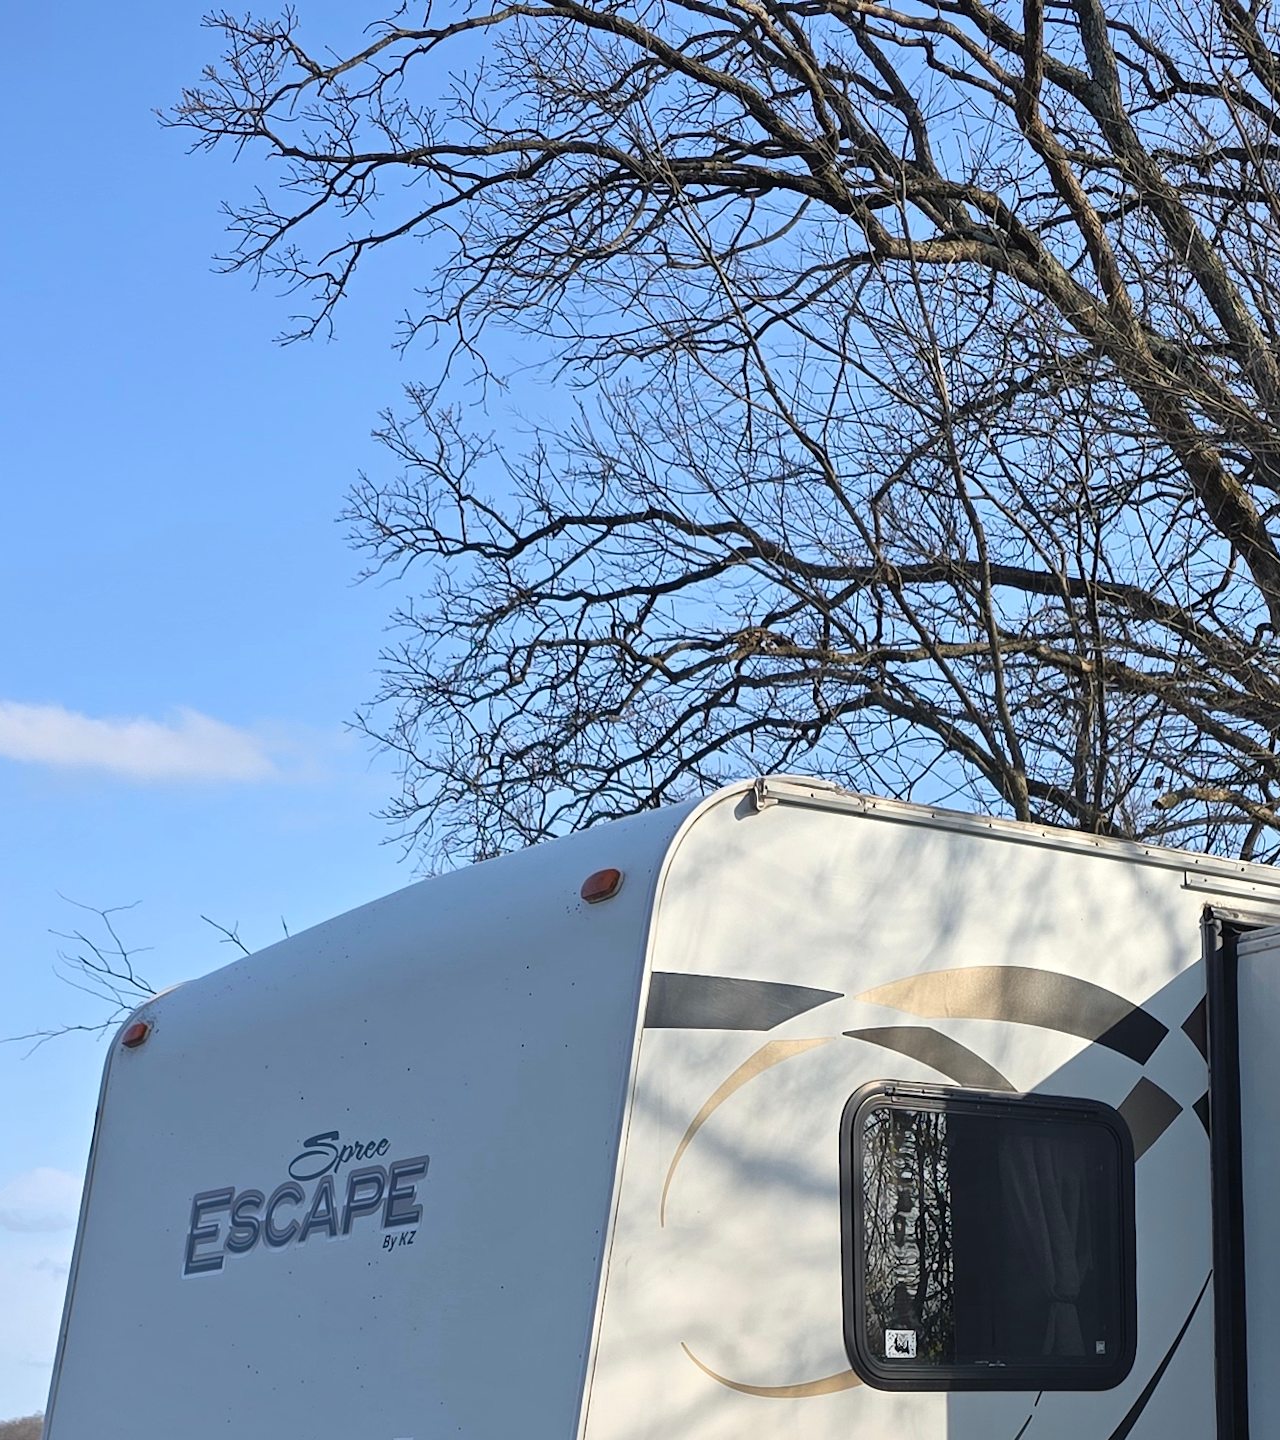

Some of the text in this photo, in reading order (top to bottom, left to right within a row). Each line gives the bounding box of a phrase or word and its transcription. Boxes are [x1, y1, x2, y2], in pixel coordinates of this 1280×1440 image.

[288, 1130, 391, 1181] Spree
[182, 1155, 430, 1278] ESCAPE
[382, 1230, 417, 1252] By KZ
